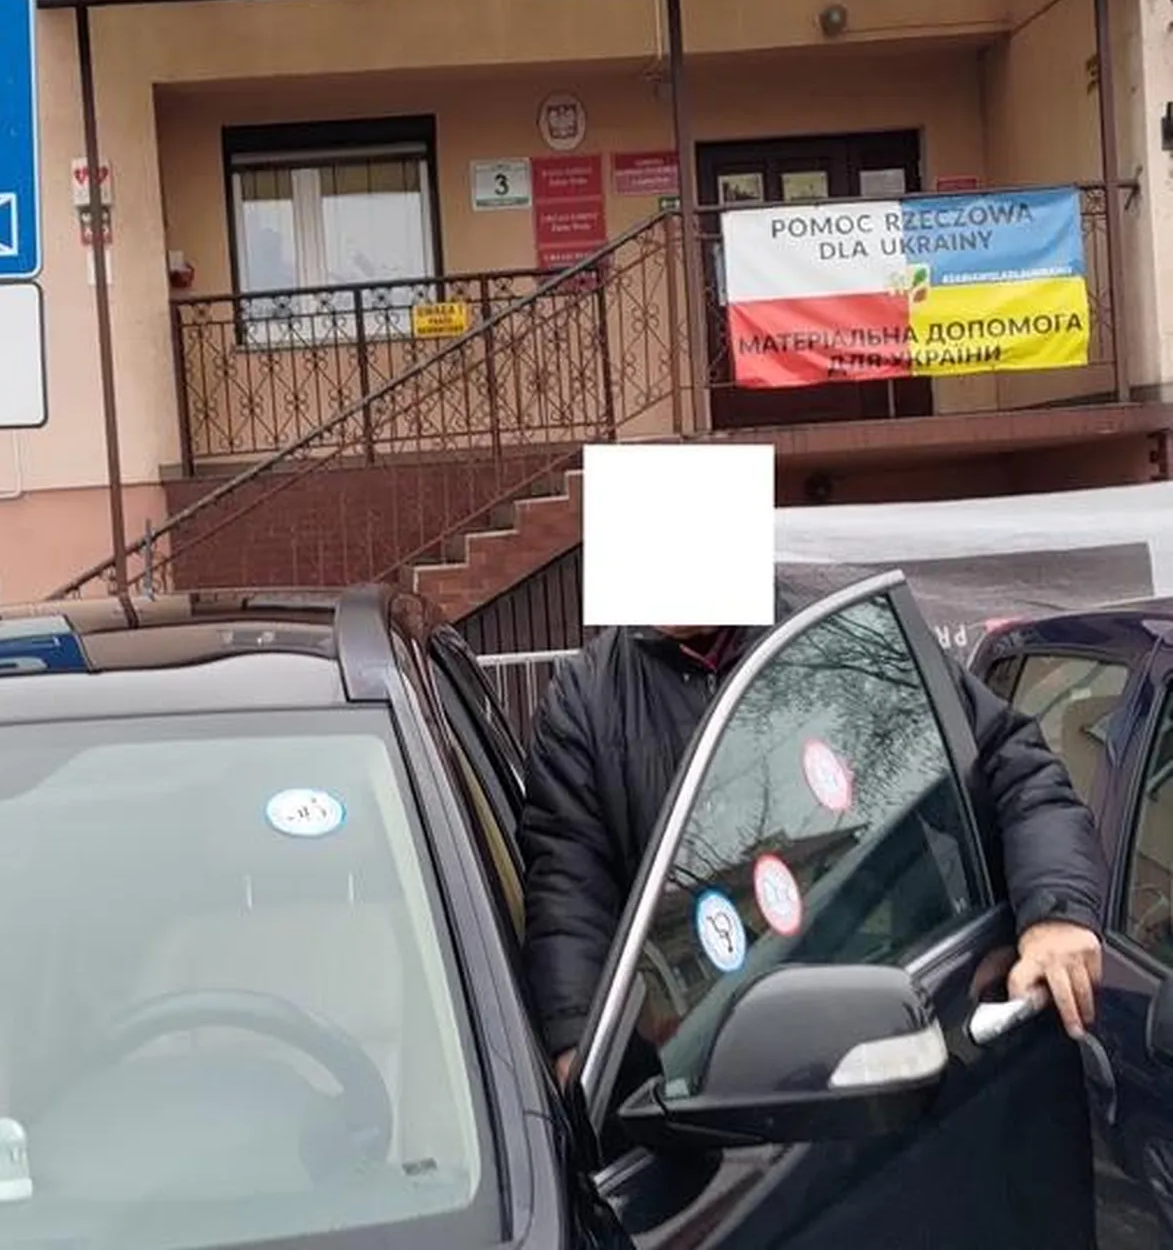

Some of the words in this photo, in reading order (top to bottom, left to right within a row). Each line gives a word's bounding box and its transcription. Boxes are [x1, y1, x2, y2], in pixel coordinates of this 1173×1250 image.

[494, 173, 509, 195] 3
[771, 213, 873, 238] POMOC
[885, 202, 1036, 233] RZECZOWA
[819, 238, 869, 261] DLA
[880, 229, 994, 257] UKRAINY
[738, 326, 919, 356] МАТЕРІАЛЬНА
[925, 312, 1084, 346] ДОПОМОГА
